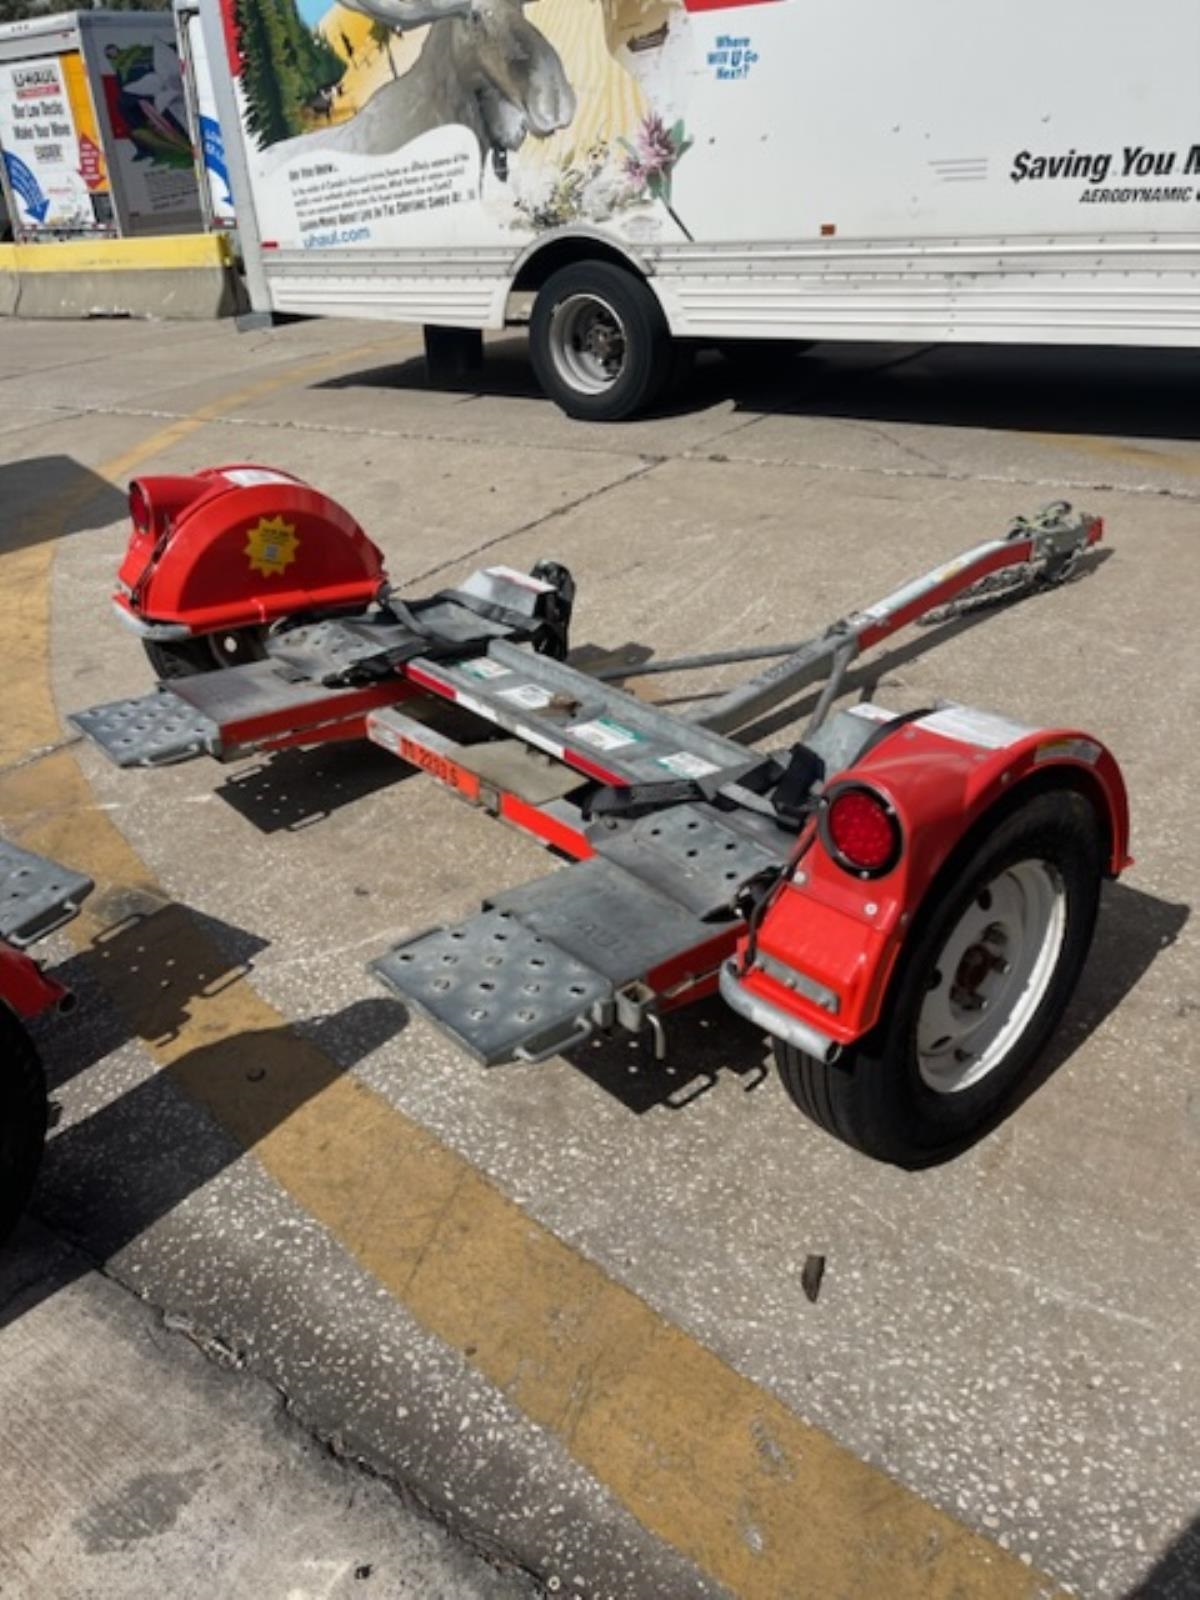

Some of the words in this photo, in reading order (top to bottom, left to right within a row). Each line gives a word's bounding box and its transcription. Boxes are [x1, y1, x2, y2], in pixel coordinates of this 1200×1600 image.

[1122, 146, 1176, 176] You
[1079, 187, 1193, 202] AERODYNAMIC
[303, 225, 371, 249] uhaul.com
